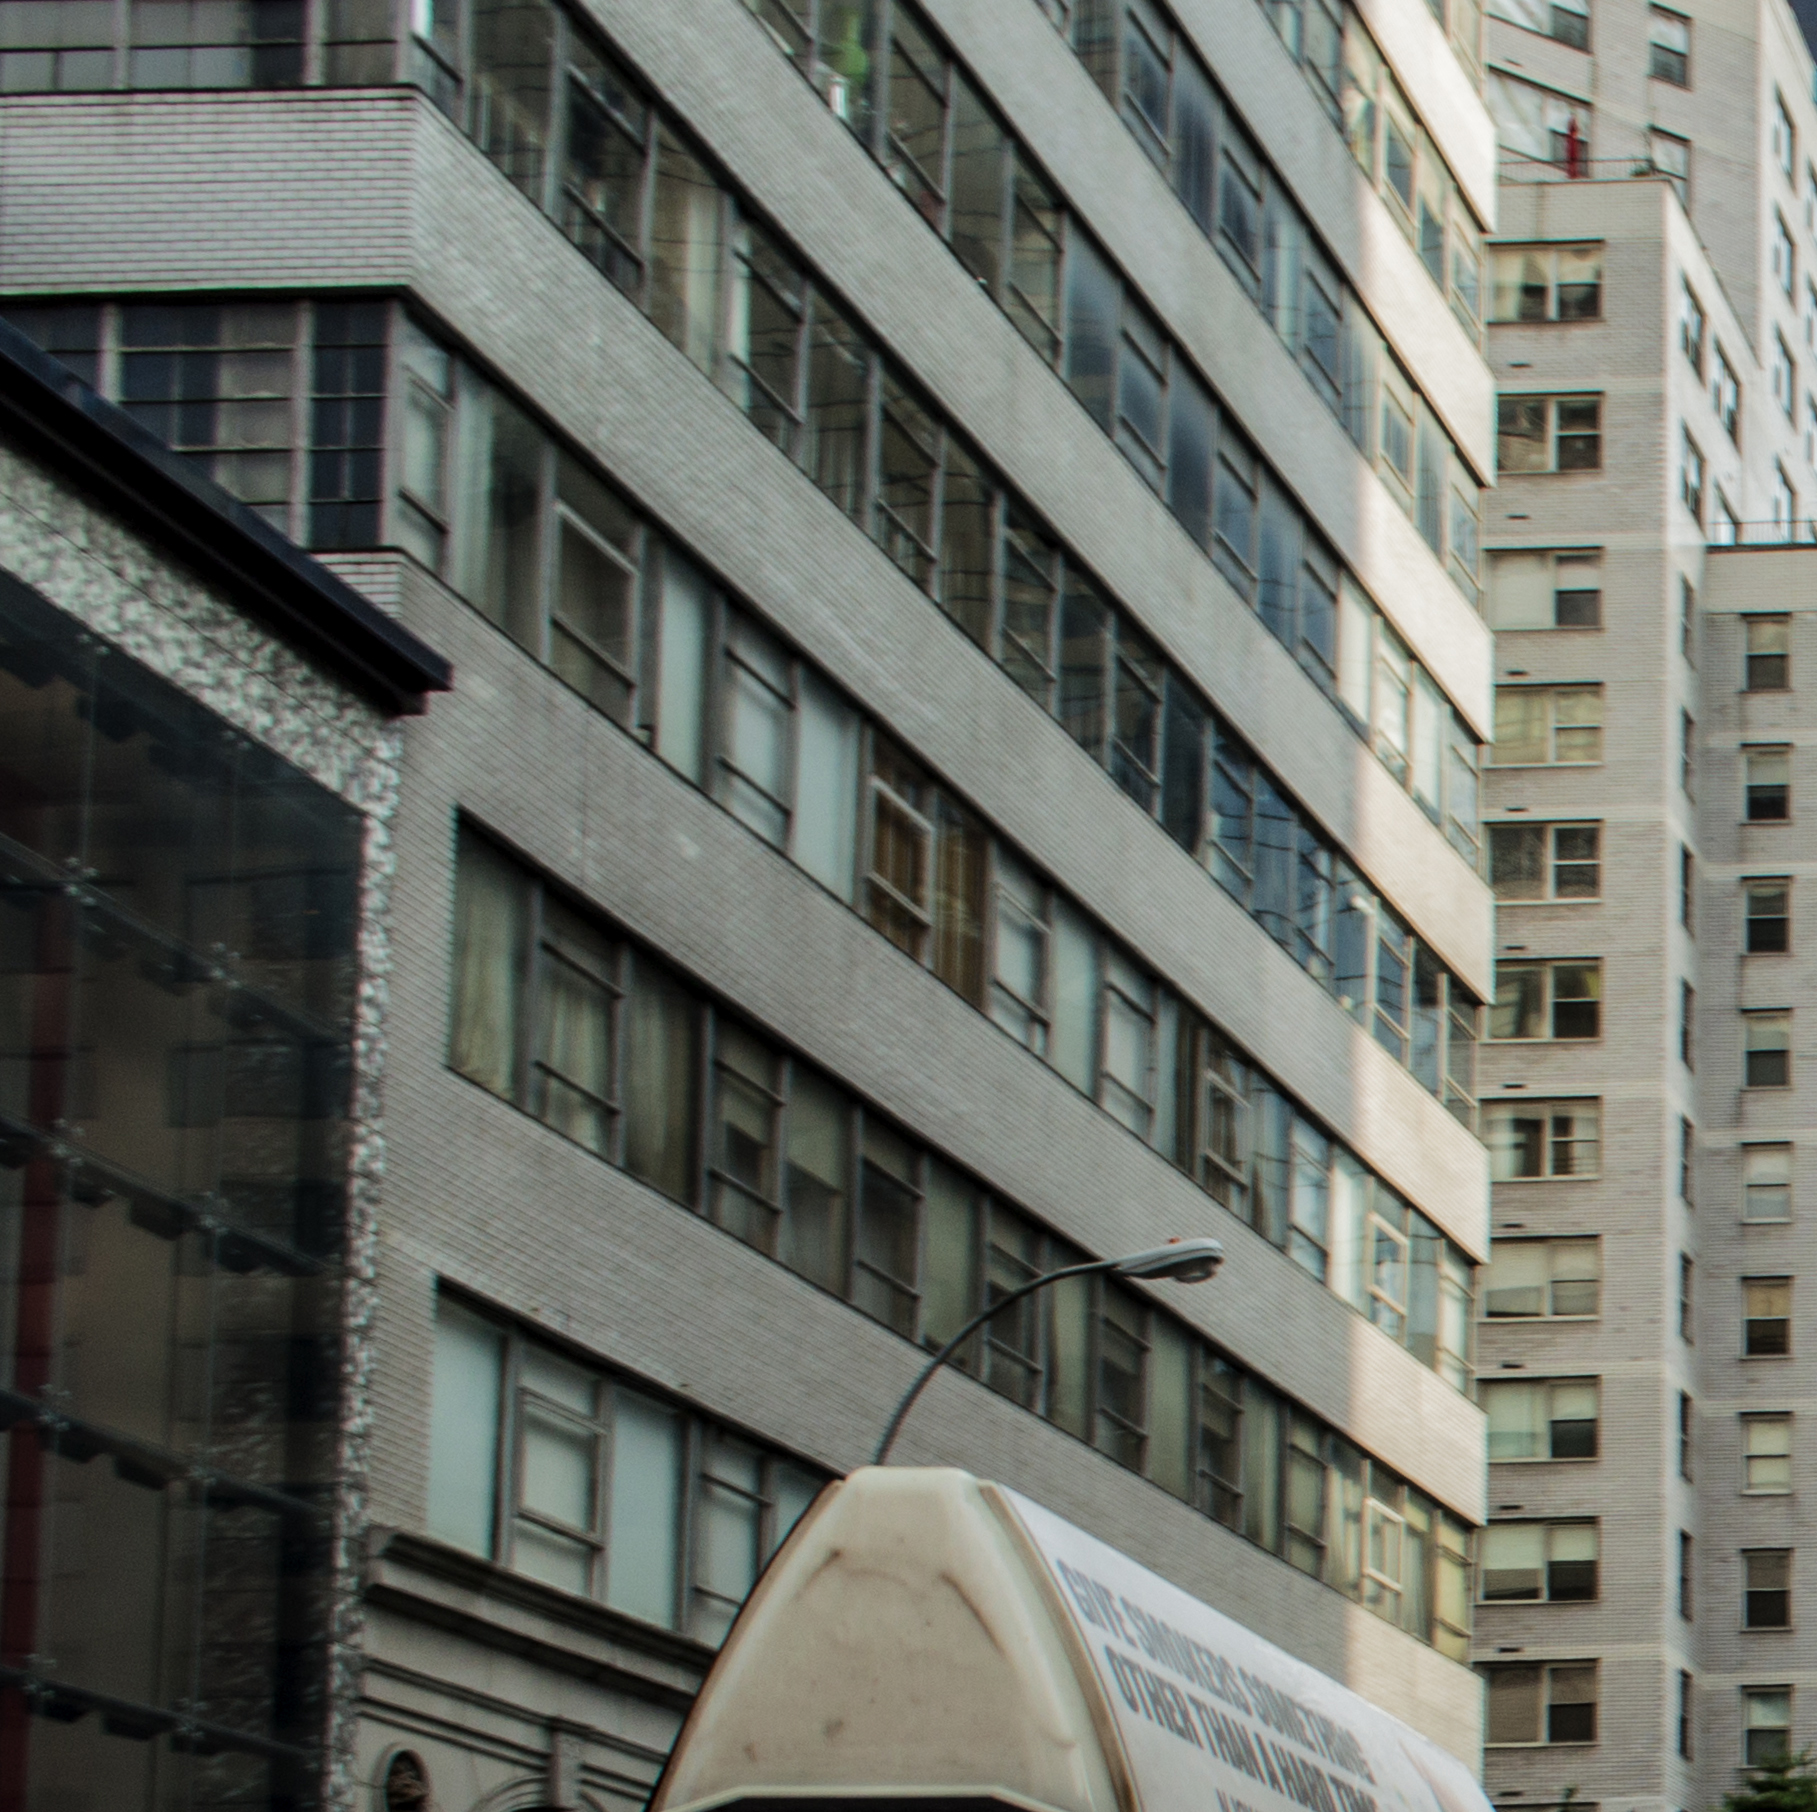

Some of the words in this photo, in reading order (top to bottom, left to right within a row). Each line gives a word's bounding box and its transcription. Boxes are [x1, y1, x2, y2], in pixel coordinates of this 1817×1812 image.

[1055, 1557, 1138, 1649] GIVE
[1119, 1596, 1253, 1718] SMOKERS
[1103, 1644, 1205, 1750] OTHER
[1184, 1690, 1267, 1785] THAN
[1253, 1730, 1286, 1796] A
